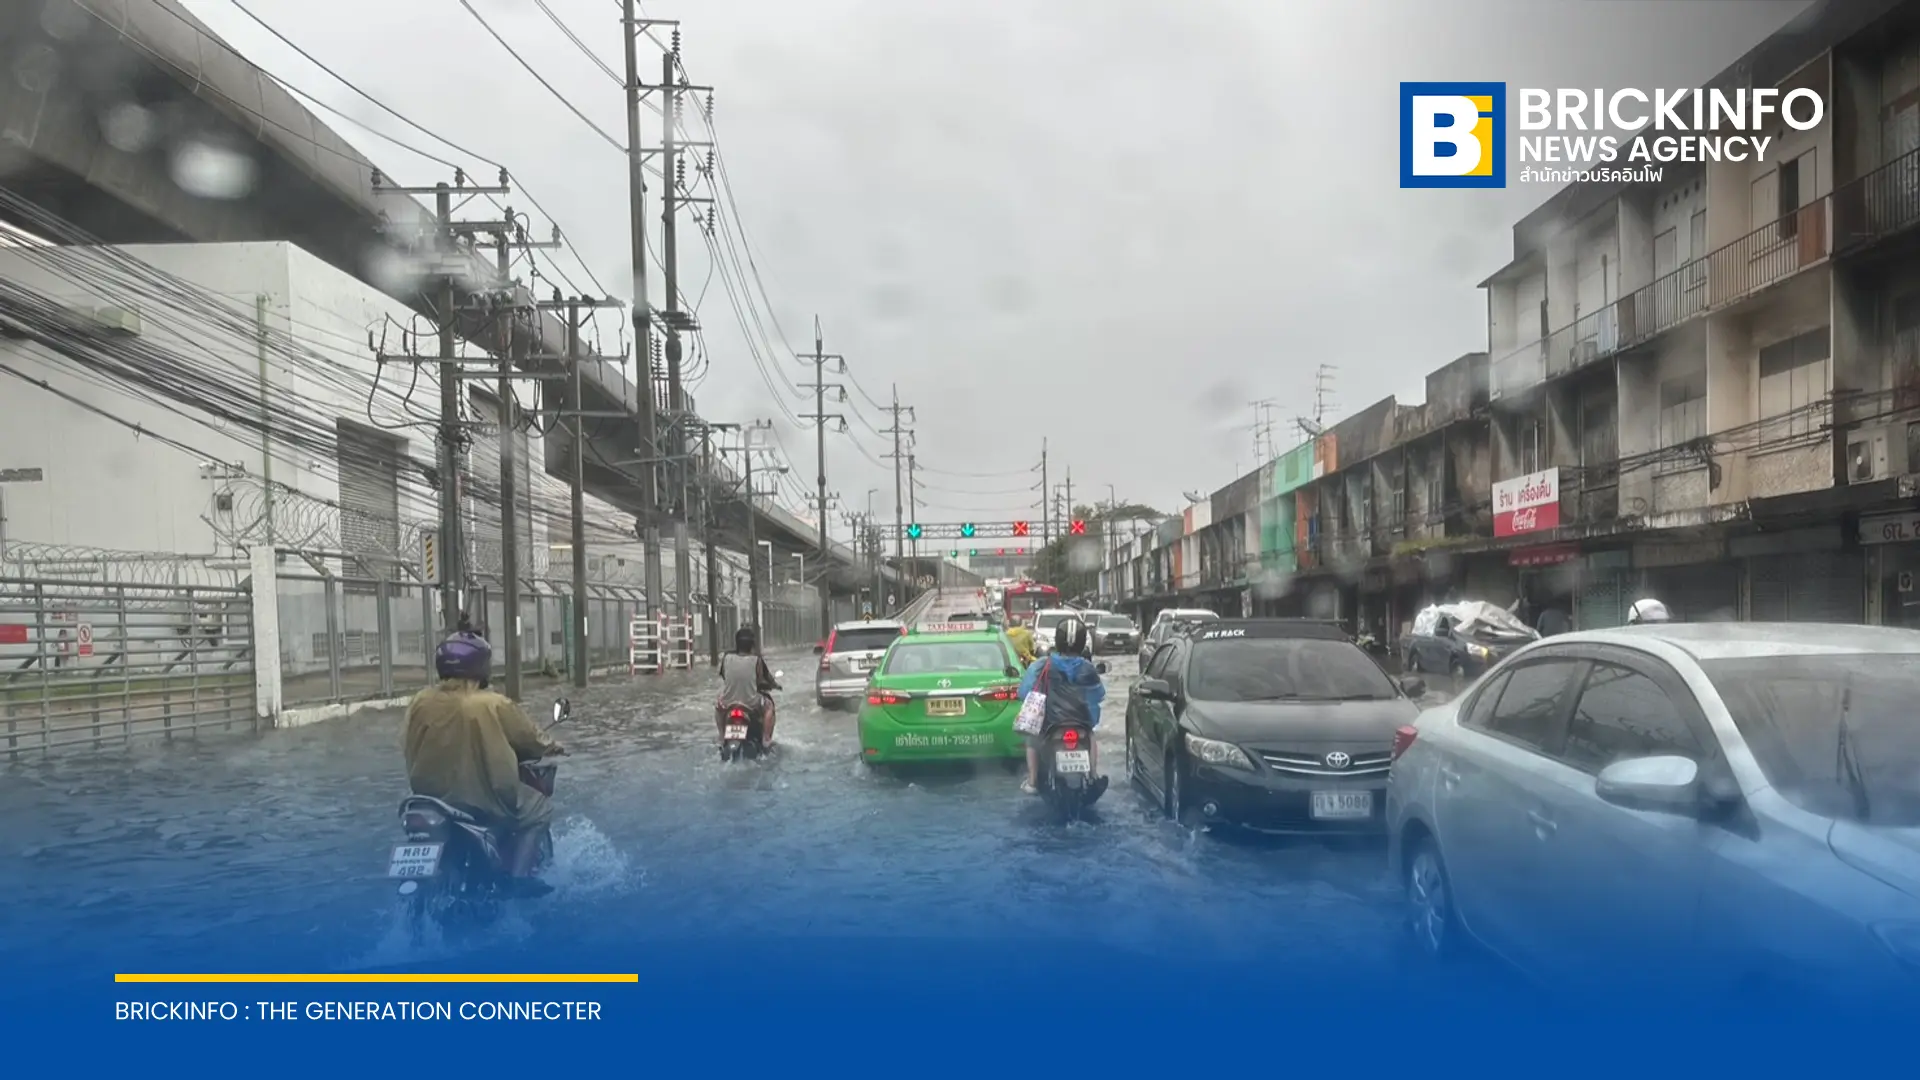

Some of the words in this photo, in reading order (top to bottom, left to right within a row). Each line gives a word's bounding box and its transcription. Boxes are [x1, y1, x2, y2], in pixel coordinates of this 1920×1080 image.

[1498, 489, 1513, 507] ร้าน
[1518, 472, 1551, 503] เครื่องดื่ม
[1220, 629, 1245, 638] RACK
